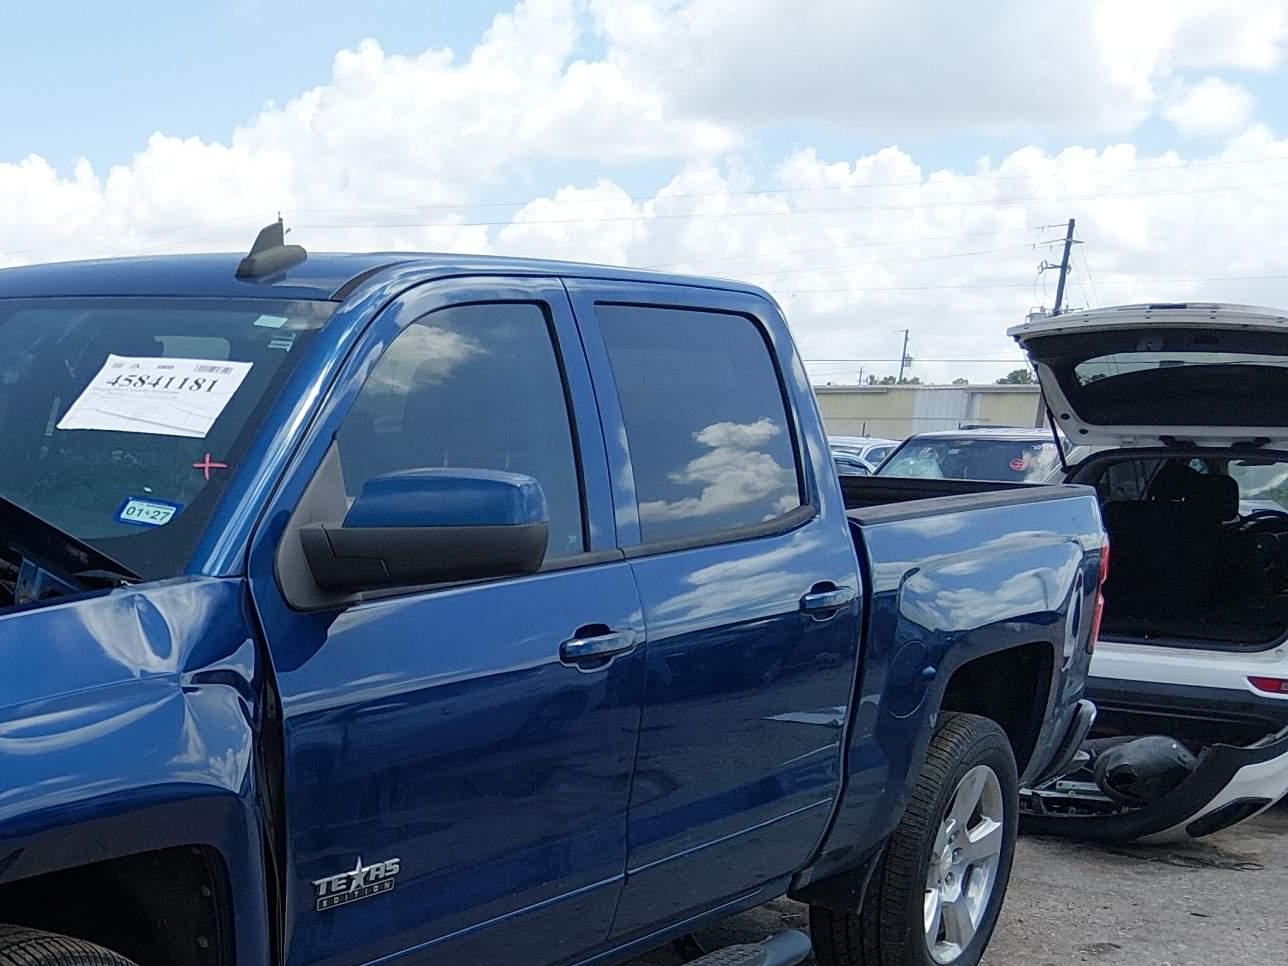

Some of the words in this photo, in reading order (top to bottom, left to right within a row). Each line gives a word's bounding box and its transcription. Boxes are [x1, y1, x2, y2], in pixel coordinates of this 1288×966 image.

[107, 374, 219, 393] 45841181
[126, 506, 143, 517] 01
[150, 510, 170, 521] 27
[312, 856, 401, 896] TEXAS
[322, 881, 391, 908] EDITION
